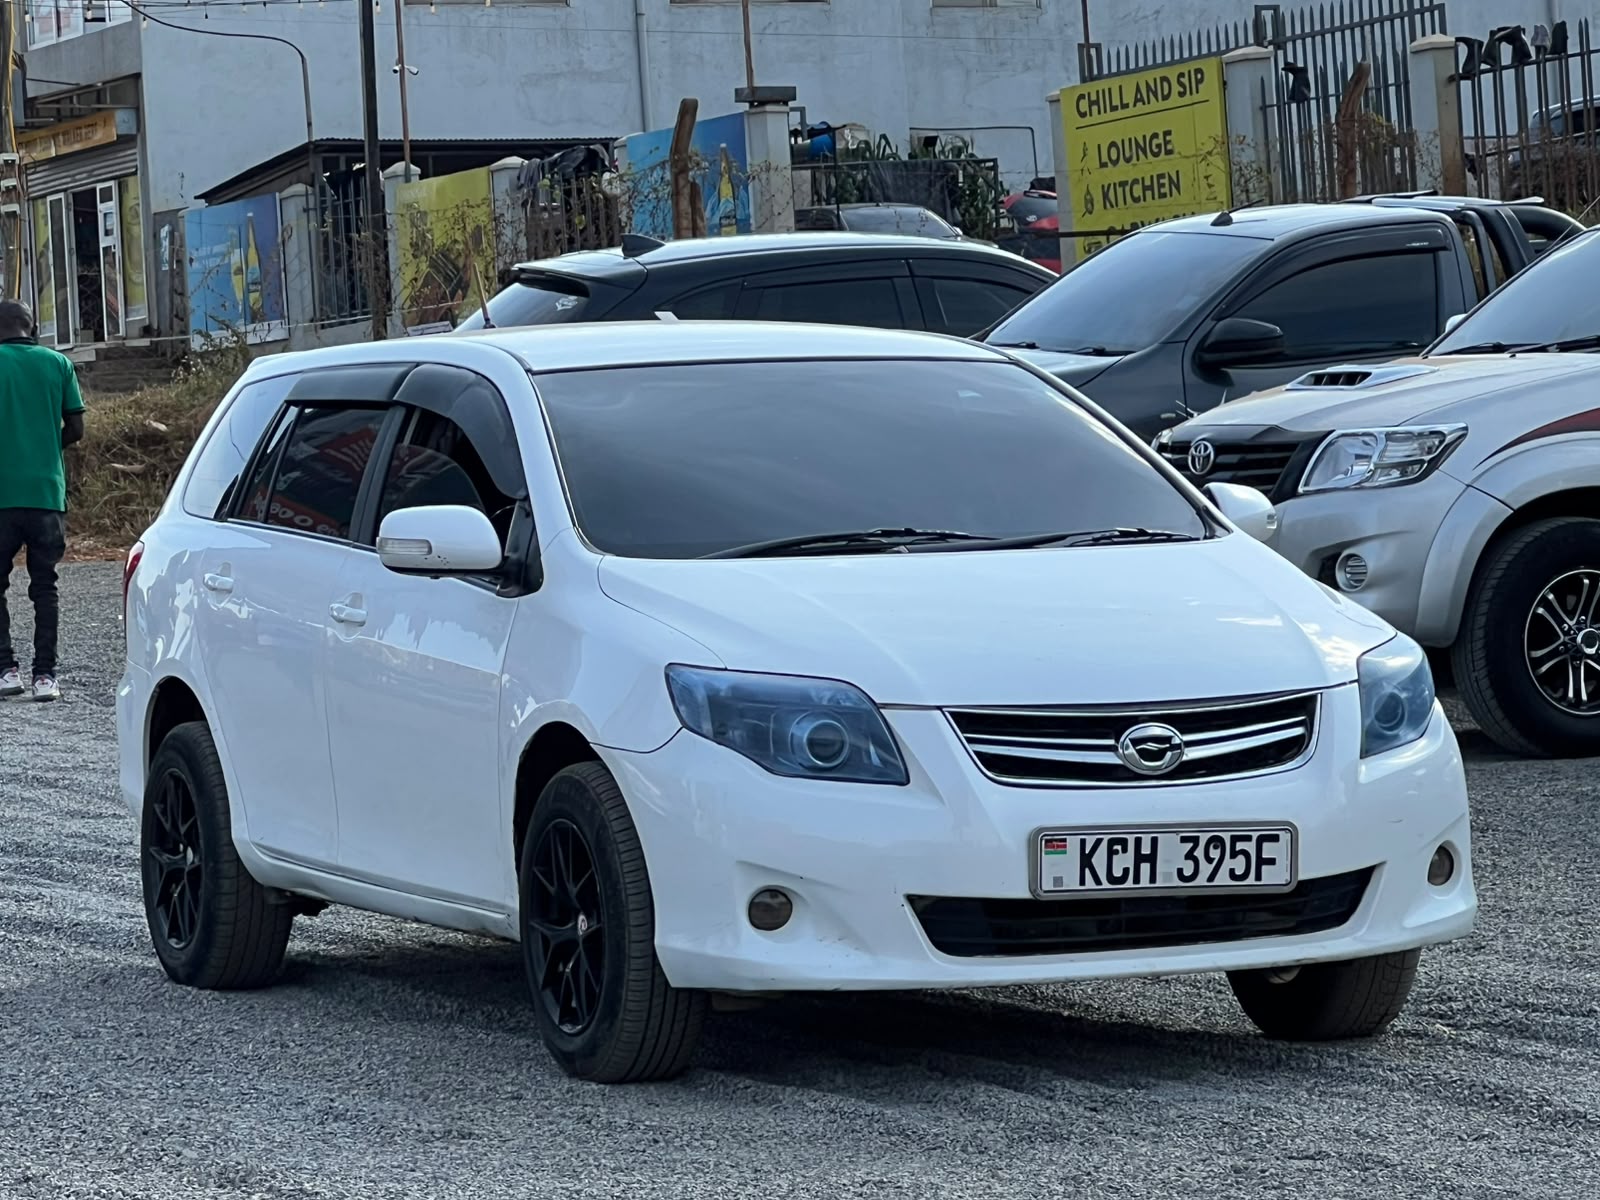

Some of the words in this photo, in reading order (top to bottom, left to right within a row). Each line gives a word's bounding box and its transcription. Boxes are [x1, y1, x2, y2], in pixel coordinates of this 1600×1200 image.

[1075, 85, 1130, 118] CHILL
[1133, 75, 1172, 108] AND
[1177, 67, 1205, 98] SIP
[1097, 129, 1175, 168] LOUNGE
[1101, 170, 1182, 209] KITCHEN
[1079, 836, 1159, 886] KCH
[1176, 833, 1280, 883] 395F
